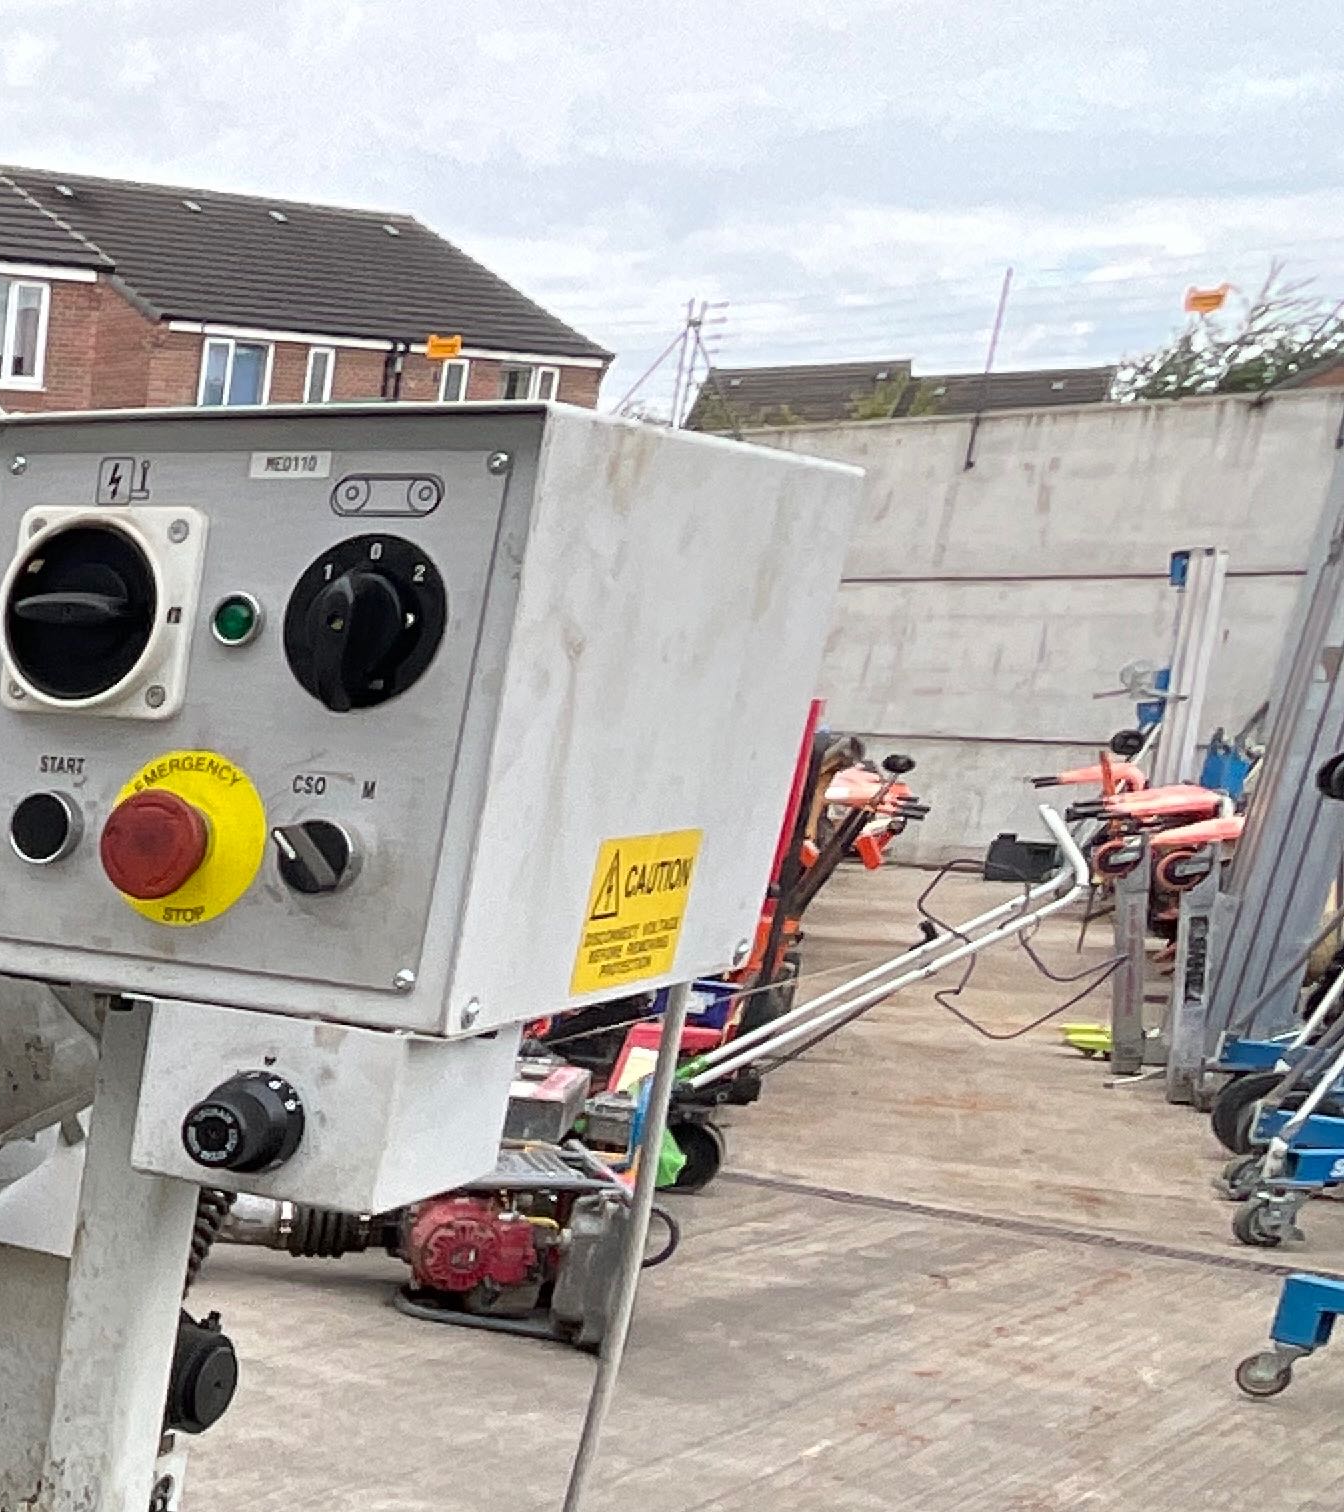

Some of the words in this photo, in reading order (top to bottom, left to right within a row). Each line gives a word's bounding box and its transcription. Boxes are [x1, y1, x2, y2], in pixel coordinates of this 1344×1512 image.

[323, 564, 333, 580] 1
[370, 543, 382, 560] 0
[413, 564, 426, 581] 2
[40, 755, 85, 774] START
[133, 756, 243, 793] EMERGENCY
[292, 774, 327, 796] CSO
[362, 781, 376, 799] M
[624, 855, 694, 898] CAUTION
[162, 906, 206, 923] STOP
